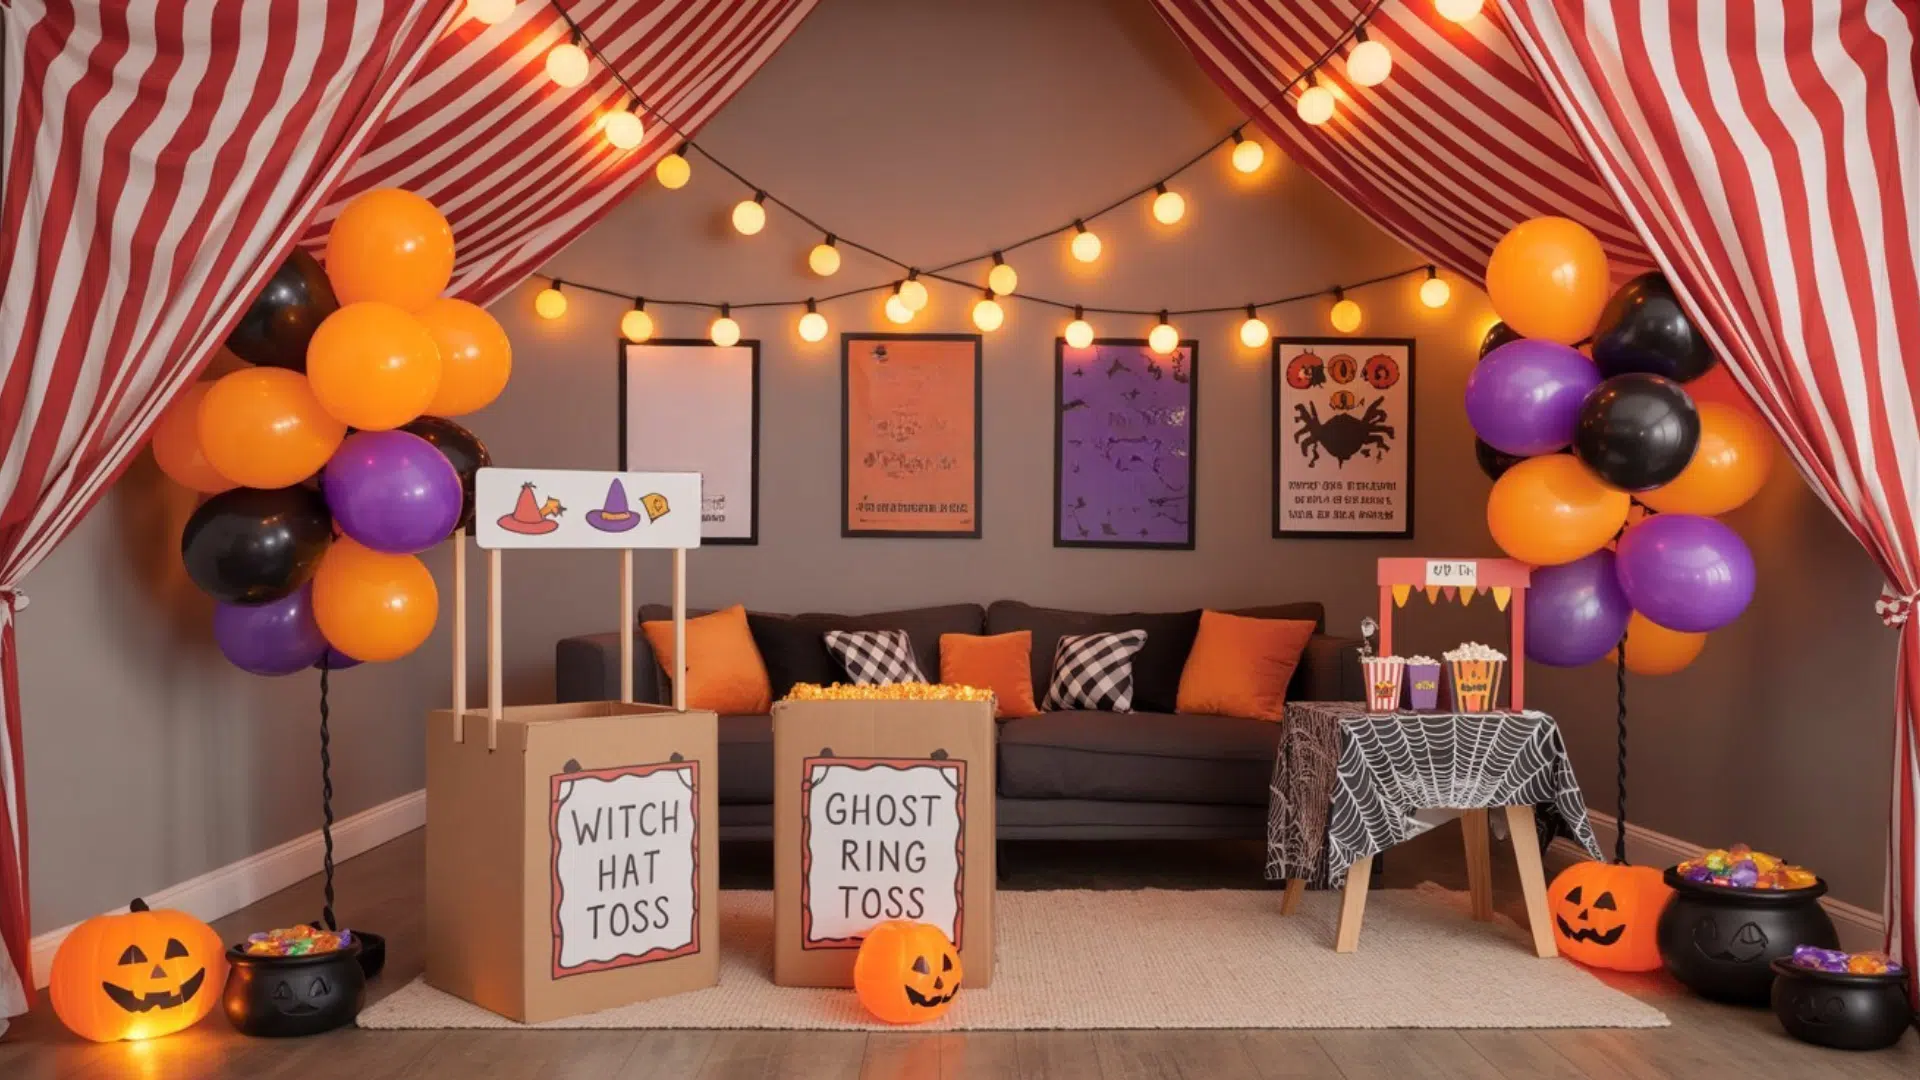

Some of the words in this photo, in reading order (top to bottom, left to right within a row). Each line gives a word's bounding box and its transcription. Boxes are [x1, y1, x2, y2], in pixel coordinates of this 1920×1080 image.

[571, 800, 680, 846] WITCH
[825, 792, 941, 827] GHOST
[598, 850, 661, 892] HAT
[841, 839, 927, 873] RING
[586, 896, 670, 940] TOSS
[838, 886, 925, 920] TOSS
